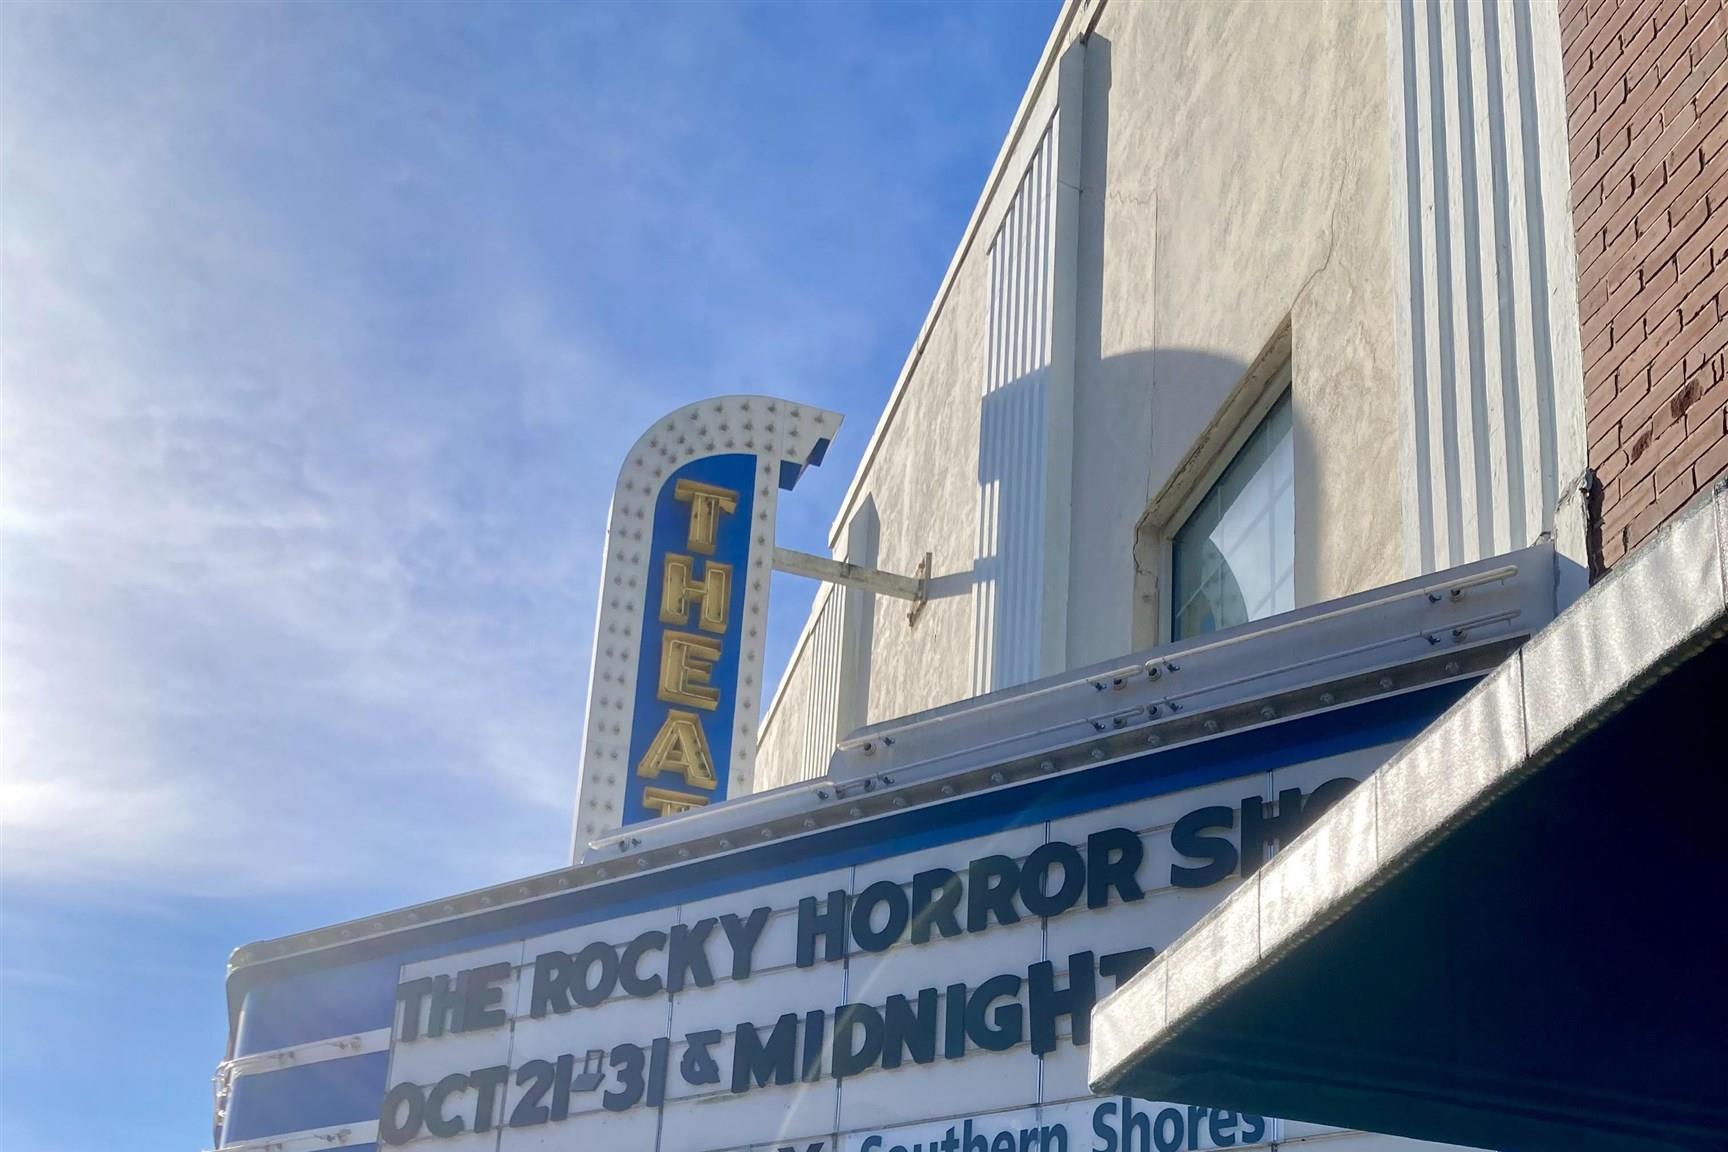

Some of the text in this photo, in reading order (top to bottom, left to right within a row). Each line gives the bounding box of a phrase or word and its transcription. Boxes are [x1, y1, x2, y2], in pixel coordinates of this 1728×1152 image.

[398, 777, 1361, 1042] THE ROCKY HORROR SH
[380, 1065, 509, 1146] OCT
[680, 1028, 722, 1086] &
